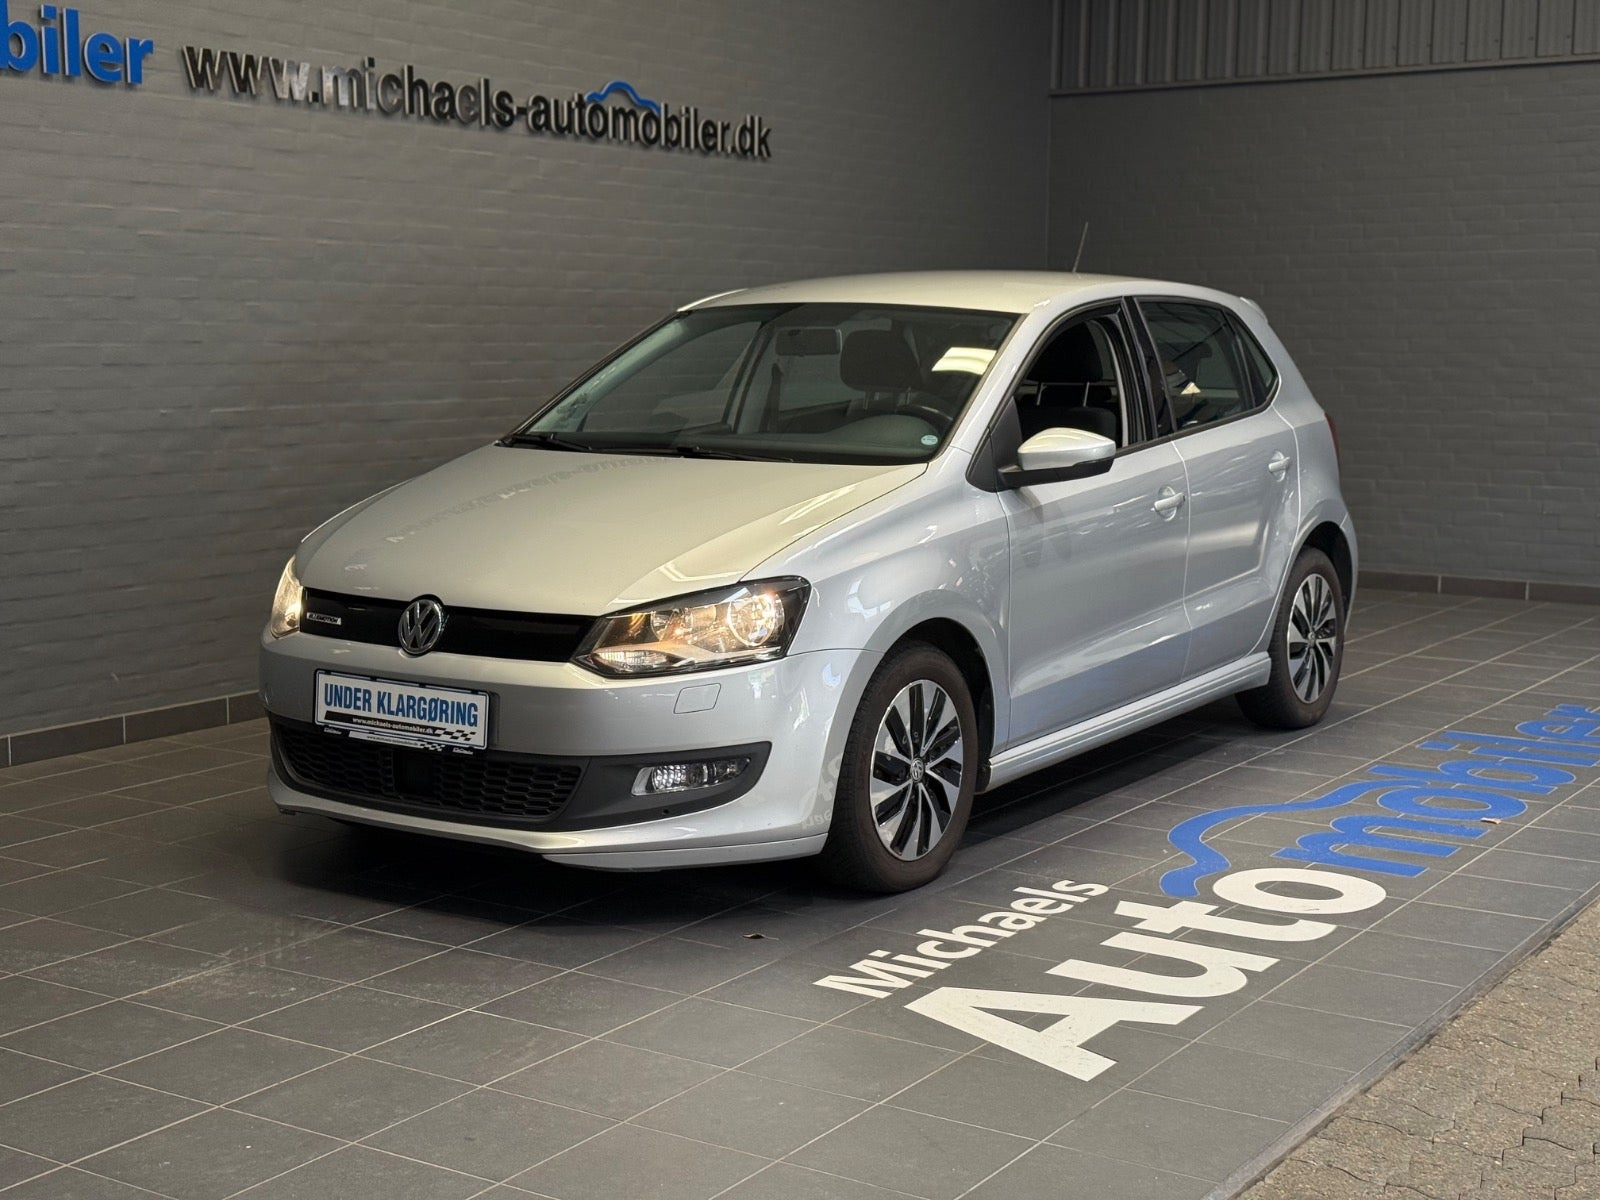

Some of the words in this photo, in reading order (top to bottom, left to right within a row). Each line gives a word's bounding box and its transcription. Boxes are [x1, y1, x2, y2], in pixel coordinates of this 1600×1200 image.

[183, 46, 771, 158] www.michaels-automobiler.dk
[324, 682, 372, 712] UNDER
[376, 690, 479, 727] KLARGØRING
[352, 717, 433, 735] www.michaels-automobiler.dk
[812, 879, 1109, 999] Michaels
